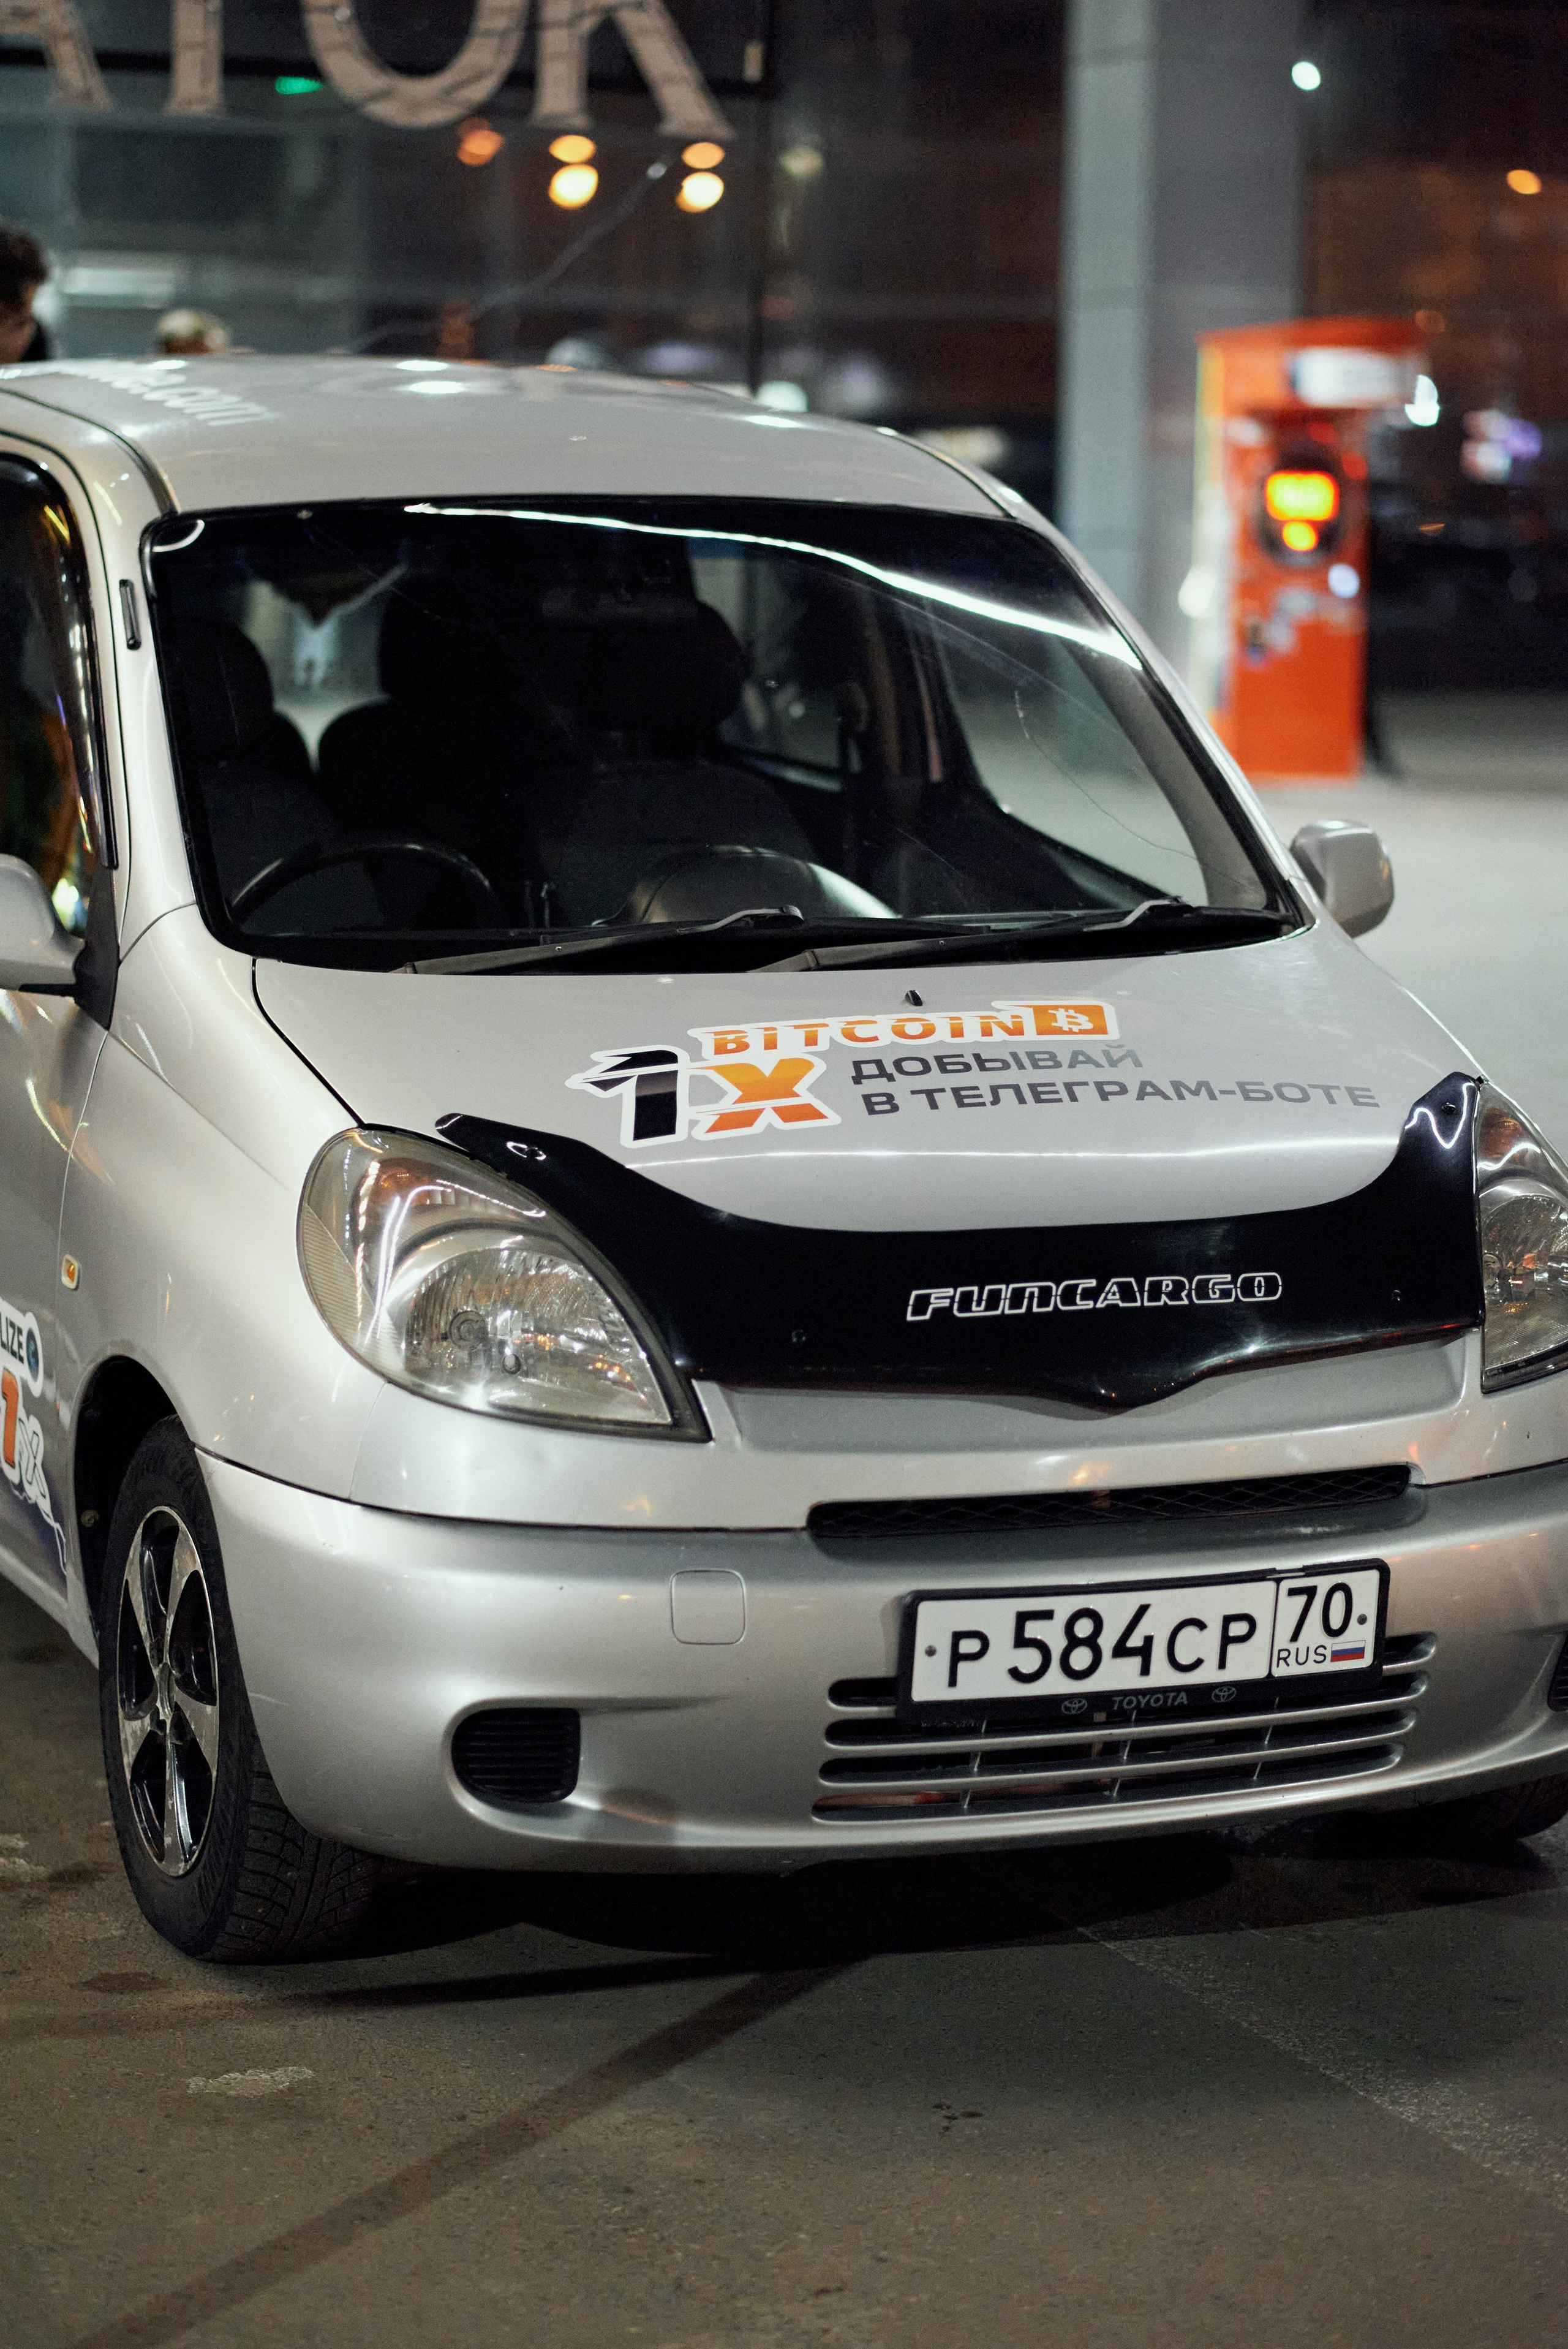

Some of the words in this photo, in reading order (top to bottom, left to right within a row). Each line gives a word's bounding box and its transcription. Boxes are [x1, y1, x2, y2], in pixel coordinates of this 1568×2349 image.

[702, 1013, 1025, 1055] BITCOIN
[851, 1043, 1144, 1085] ДОБЫВАЙ
[861, 1092, 900, 1116] В
[910, 1080, 1381, 1110] ТЕЛЕГРАМ-БОТЕ
[907, 1273, 1282, 1321] FUNCARGO
[1287, 1583, 1354, 1643] 70
[1276, 1644, 1327, 1668] RUS
[1112, 1692, 1188, 1710] TOYOTA
